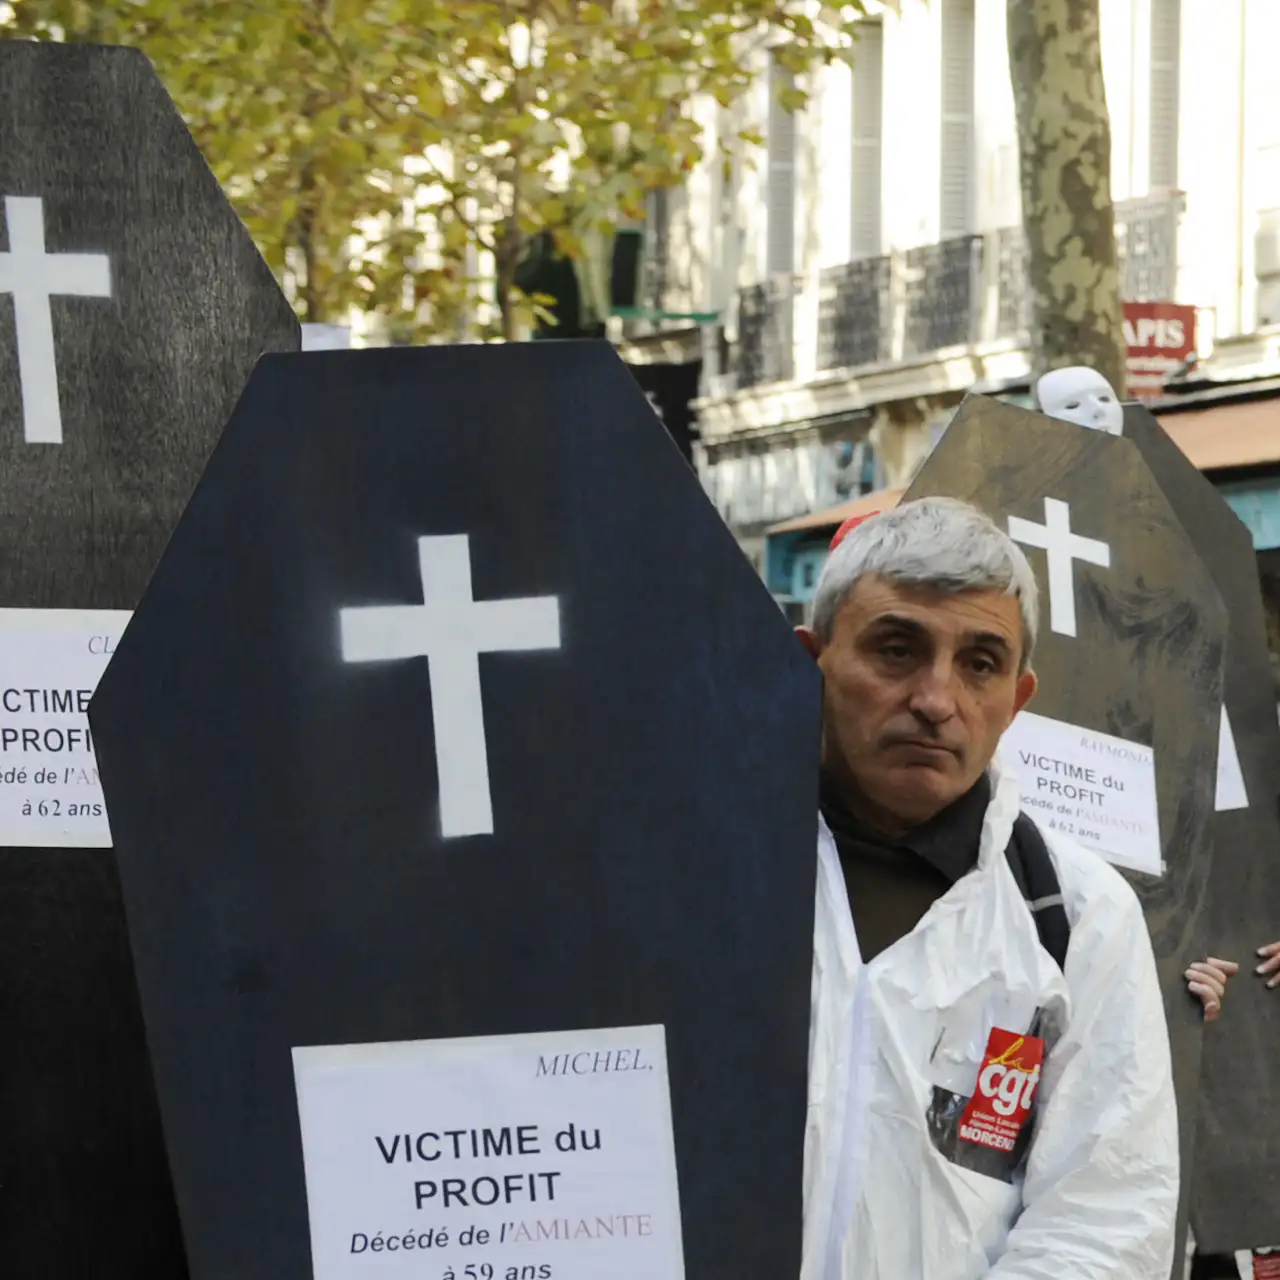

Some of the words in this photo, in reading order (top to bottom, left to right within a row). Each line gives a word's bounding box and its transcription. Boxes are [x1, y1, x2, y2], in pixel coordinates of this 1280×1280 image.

[1122, 318, 1185, 348] APIS
[88, 636, 116, 654] CL
[3, 689, 93, 713] CTIME
[1, 728, 93, 752] PROFI
[34, 767, 57, 784] de
[1018, 749, 1097, 784] VICTIME
[1102, 775, 1124, 791] du
[1019, 793, 1054, 811] cédé
[1057, 804, 1072, 816] de
[1037, 776, 1105, 806] PROFIT
[22, 799, 33, 816] à
[38, 800, 62, 817] 62
[68, 804, 102, 816] ans
[1048, 818, 1056, 829] à
[1078, 827, 1101, 840] ans
[978, 1063, 1041, 1116] cgt
[375, 1125, 541, 1164] VICTIME
[555, 1123, 601, 1153] du
[414, 1172, 561, 1210] PROFIT
[350, 1225, 449, 1254] Décédé
[459, 1224, 490, 1247] de
[500, 1214, 654, 1243] l'AMIANTE
